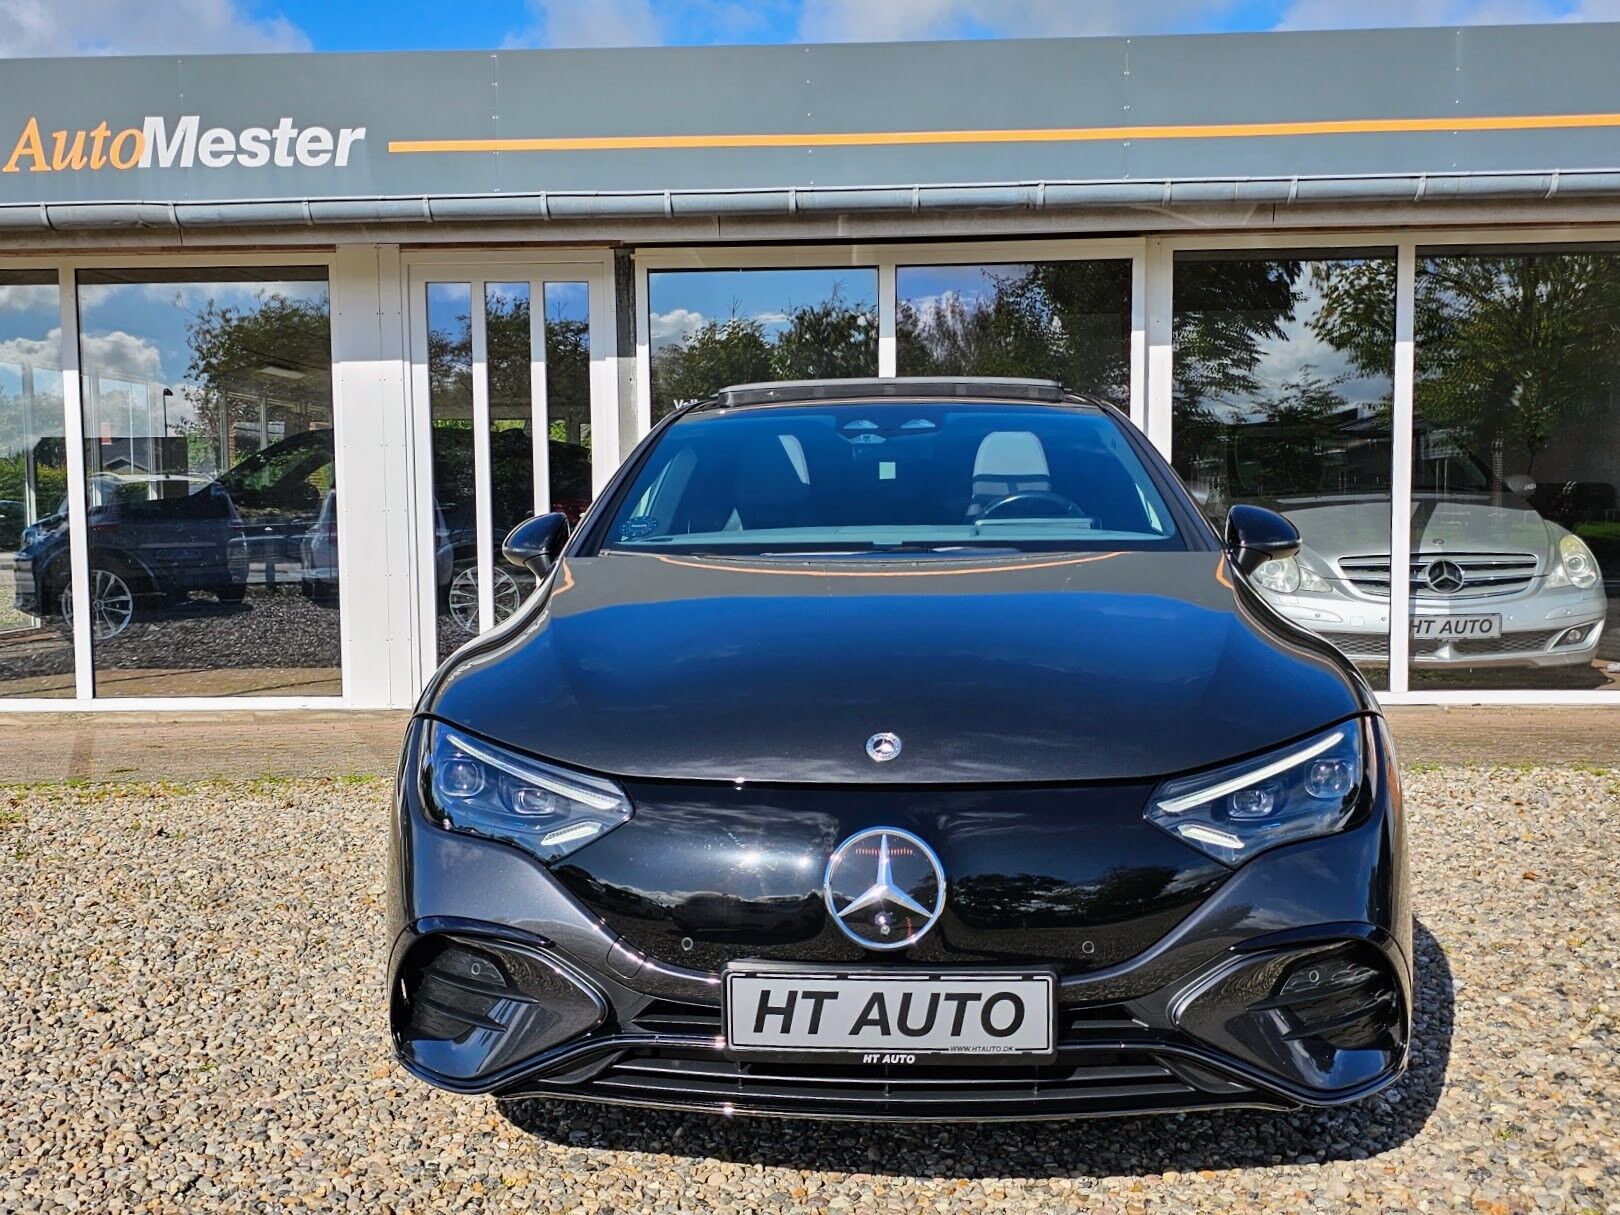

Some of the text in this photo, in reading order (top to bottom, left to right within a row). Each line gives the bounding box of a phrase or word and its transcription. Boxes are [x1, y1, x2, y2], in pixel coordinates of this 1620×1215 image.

[2, 115, 366, 173] AutoMester
[1439, 618, 1493, 634] AUTO
[753, 990, 1026, 1038] HT AUTO
[863, 1054, 916, 1064] HT AUTO
